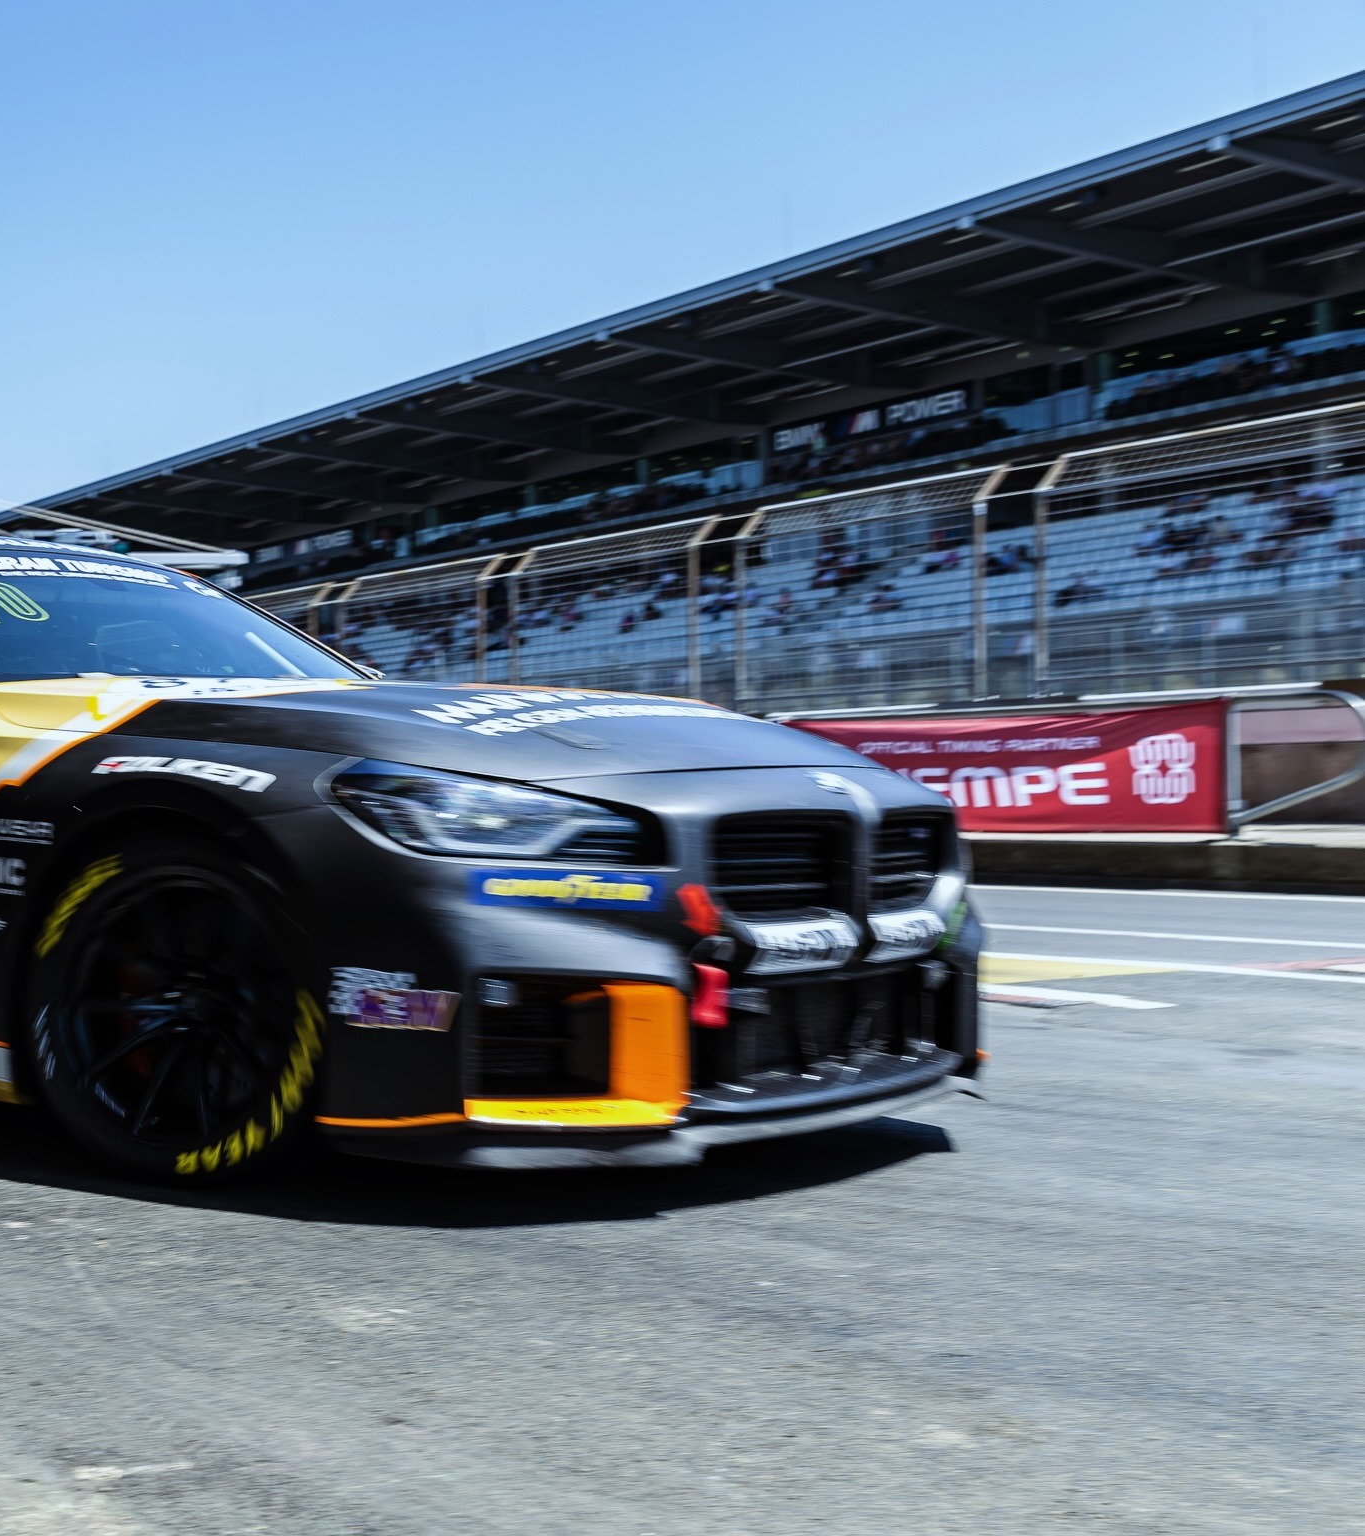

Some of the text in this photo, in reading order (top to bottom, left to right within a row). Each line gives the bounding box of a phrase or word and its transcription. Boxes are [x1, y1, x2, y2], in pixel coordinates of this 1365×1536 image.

[886, 389, 968, 427] POWER
[857, 736, 1103, 755] OFFICIAL TIMING PARTNER
[90, 756, 277, 793] FALKEN
[896, 762, 1111, 808] EMPE
